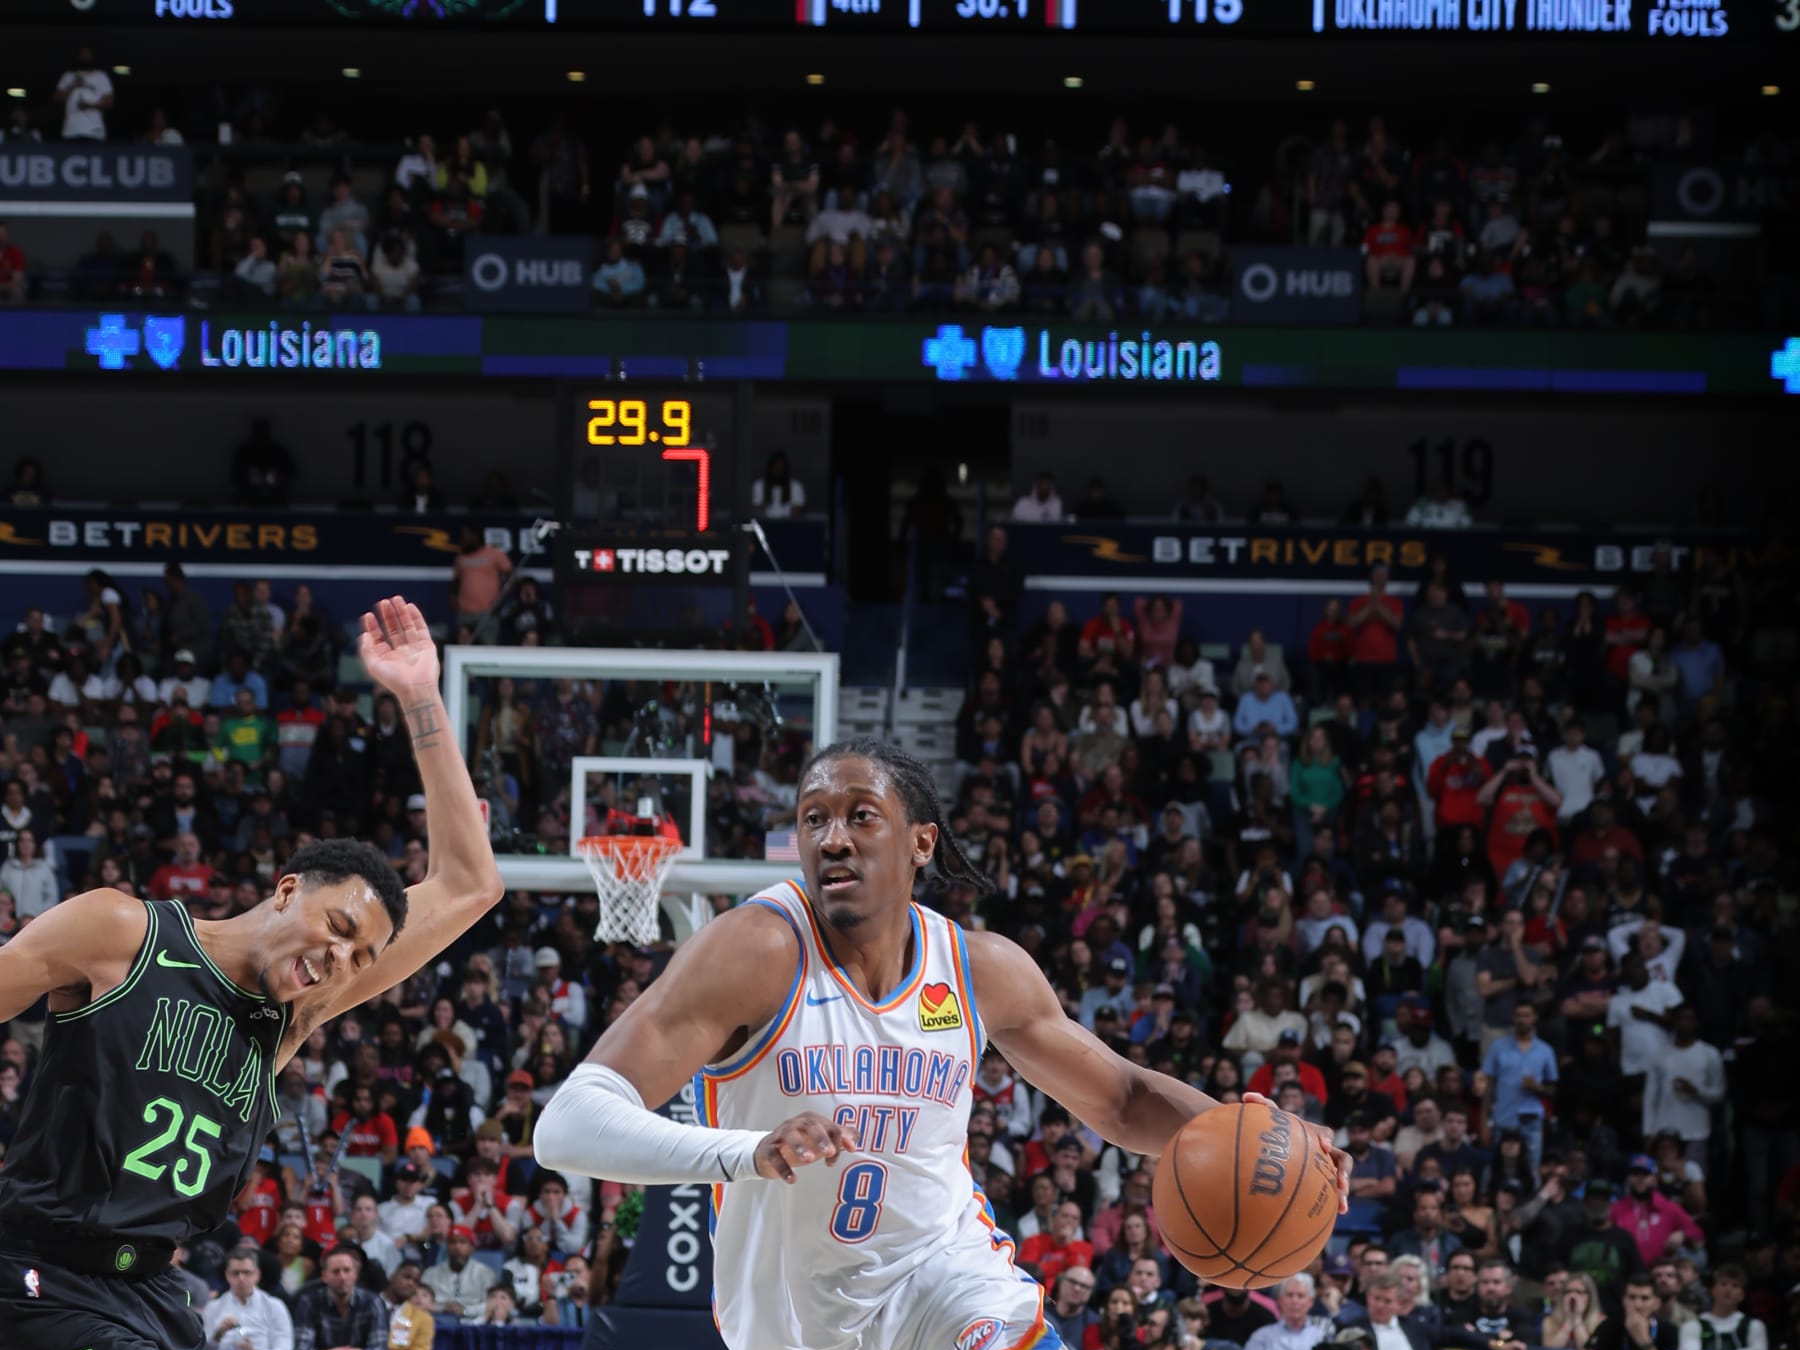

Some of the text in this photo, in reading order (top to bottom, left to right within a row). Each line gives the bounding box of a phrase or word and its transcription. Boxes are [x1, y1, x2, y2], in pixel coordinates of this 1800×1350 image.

[1648, 9, 1729, 37] FOULS
[61, 156, 176, 187] CLUB
[516, 259, 582, 285] HUB
[1287, 269, 1353, 295] HUB
[201, 319, 382, 369] Louisiana
[1039, 329, 1222, 381] Louisiana
[587, 399, 691, 446] 29.9
[661, 447, 710, 532] 7
[48, 520, 319, 550] BETRIVERS
[1153, 536, 1427, 565] BETRIVERS
[616, 549, 730, 574] TISSOT
[136, 998, 262, 1122] NOLA
[776, 1045, 970, 1107] OKLAHOMA
[123, 1097, 223, 1198] 25
[829, 1160, 888, 1244] 8
